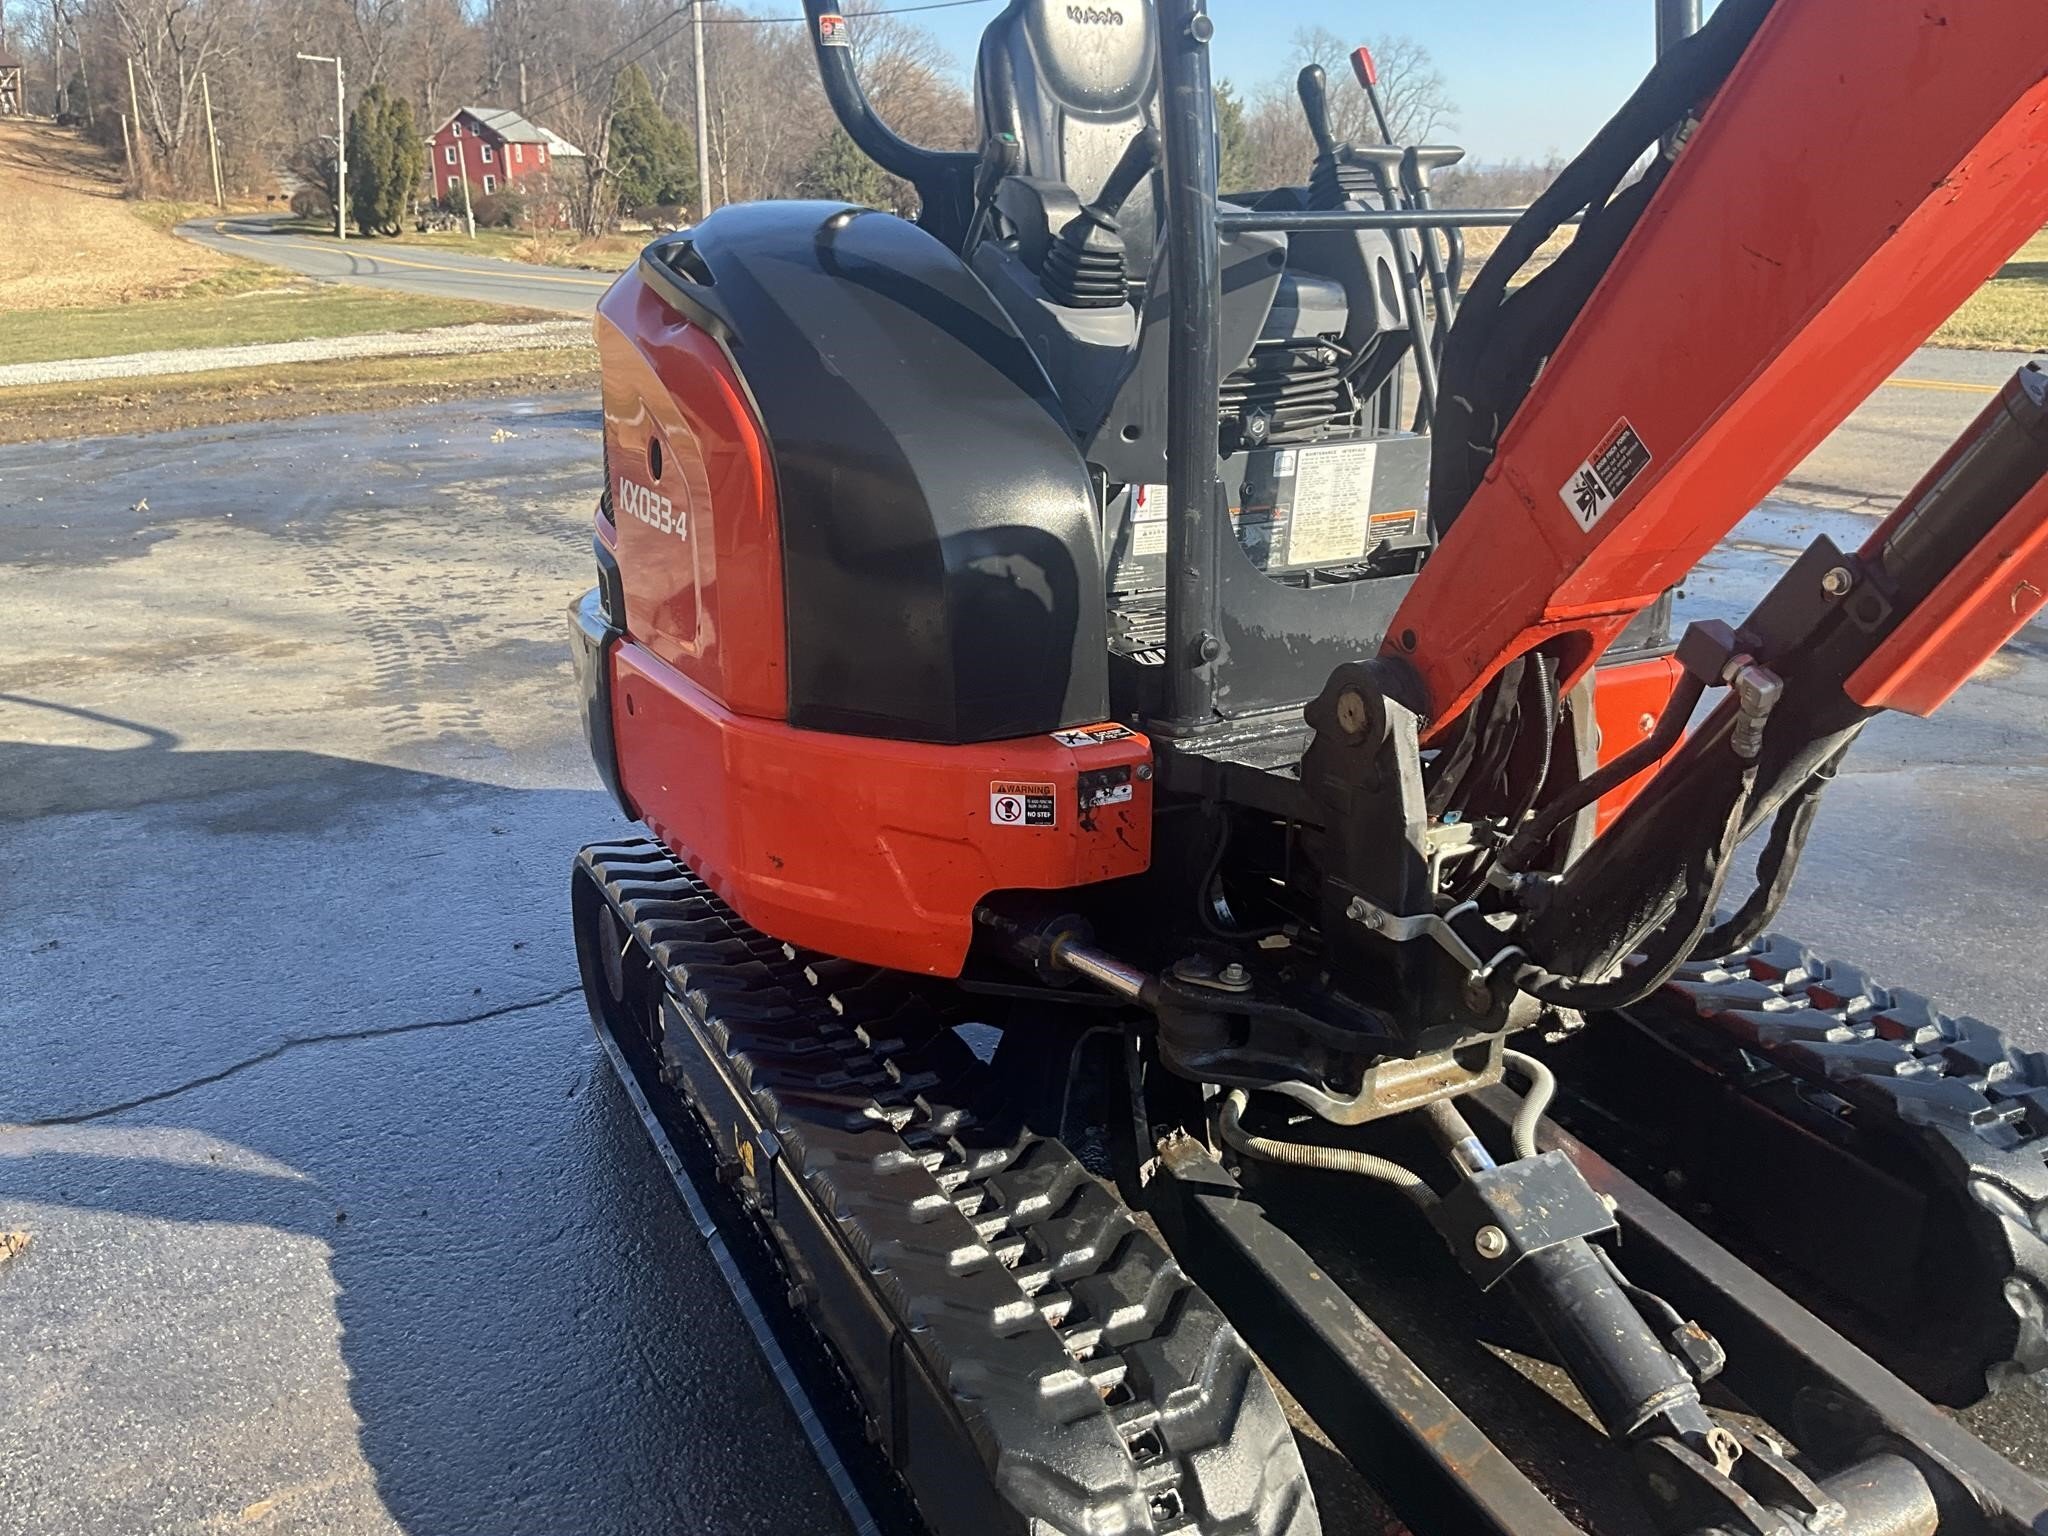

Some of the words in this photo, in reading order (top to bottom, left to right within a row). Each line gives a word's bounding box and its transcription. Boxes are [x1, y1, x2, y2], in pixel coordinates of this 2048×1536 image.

[1067, 5, 1123, 26] Kubota
[620, 477, 687, 542] KX033-4
[1007, 785, 1051, 794] WARNING
